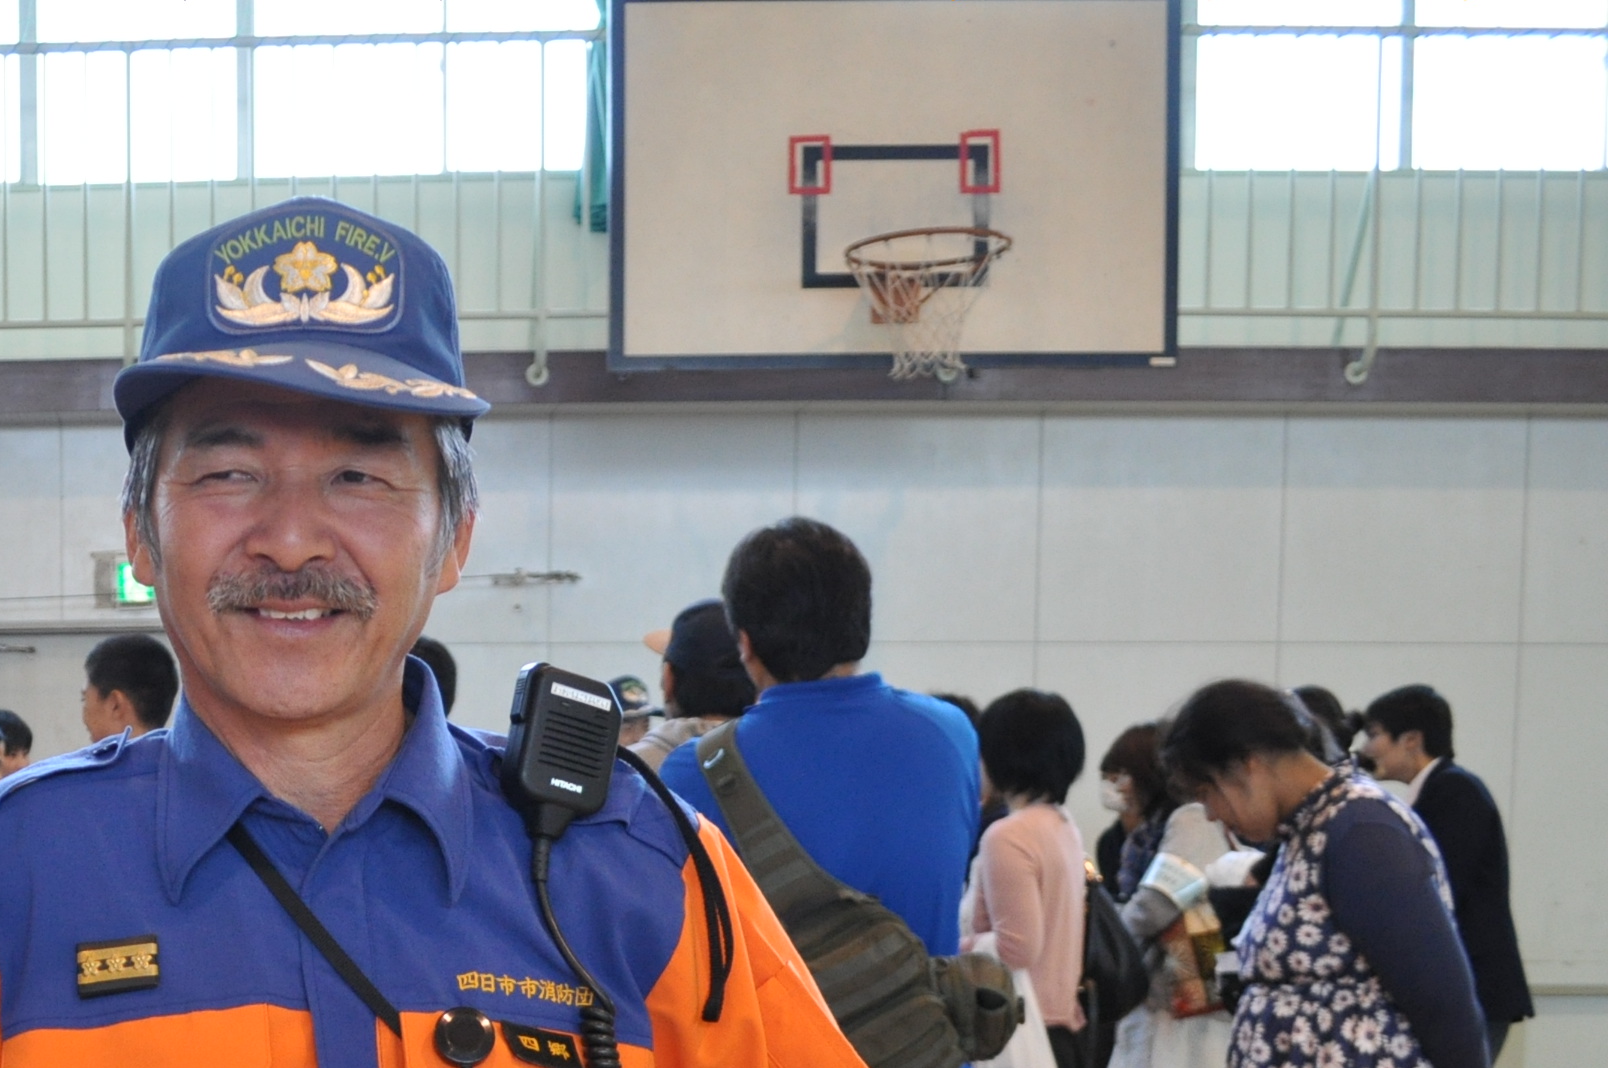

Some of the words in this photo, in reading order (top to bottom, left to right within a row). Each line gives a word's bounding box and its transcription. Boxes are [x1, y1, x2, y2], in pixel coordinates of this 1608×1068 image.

[214, 215, 325, 264] YOKKAICHI
[335, 220, 396, 262] FIRE.V
[550, 777, 583, 794] HITACHI
[456, 970, 594, 1007] 四日市市消防団
